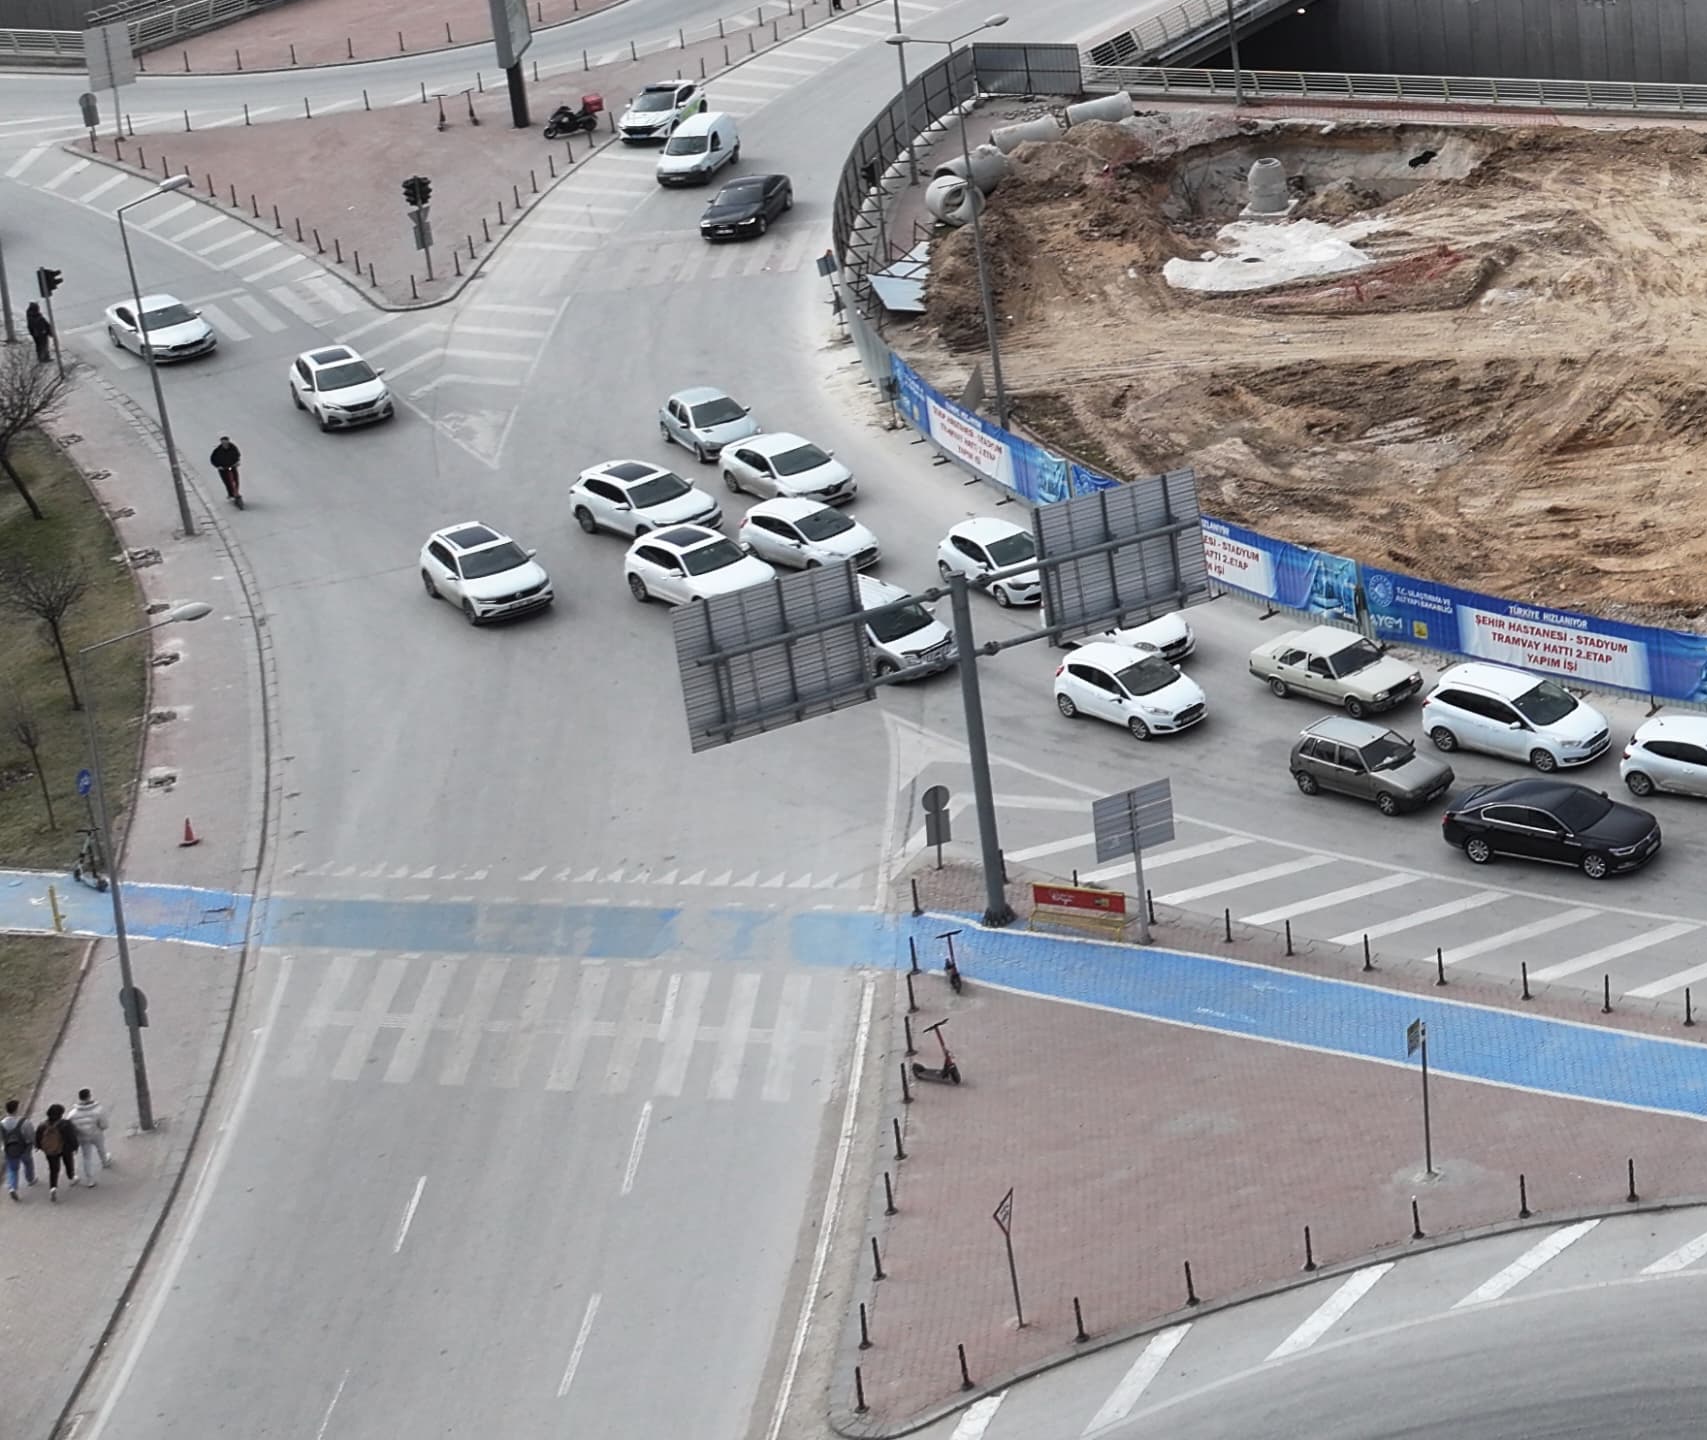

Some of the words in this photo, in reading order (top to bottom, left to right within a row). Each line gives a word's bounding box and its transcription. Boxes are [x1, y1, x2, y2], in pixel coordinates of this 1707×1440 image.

[1205, 549, 1222, 563] ATTI
[1222, 541, 1260, 562] STADYUM
[1474, 614, 1505, 630] ŞEHİR
[1508, 620, 1568, 642] HASTANESİ
[1576, 635, 1628, 653] STADYUM
[1491, 631, 1541, 650] TRAMVAY
[1543, 644, 1573, 657] HATTI
[1575, 649, 1613, 665] 2.ETAP
[1527, 654, 1561, 669] YAPIM
[1563, 660, 1578, 673] İŞİ
